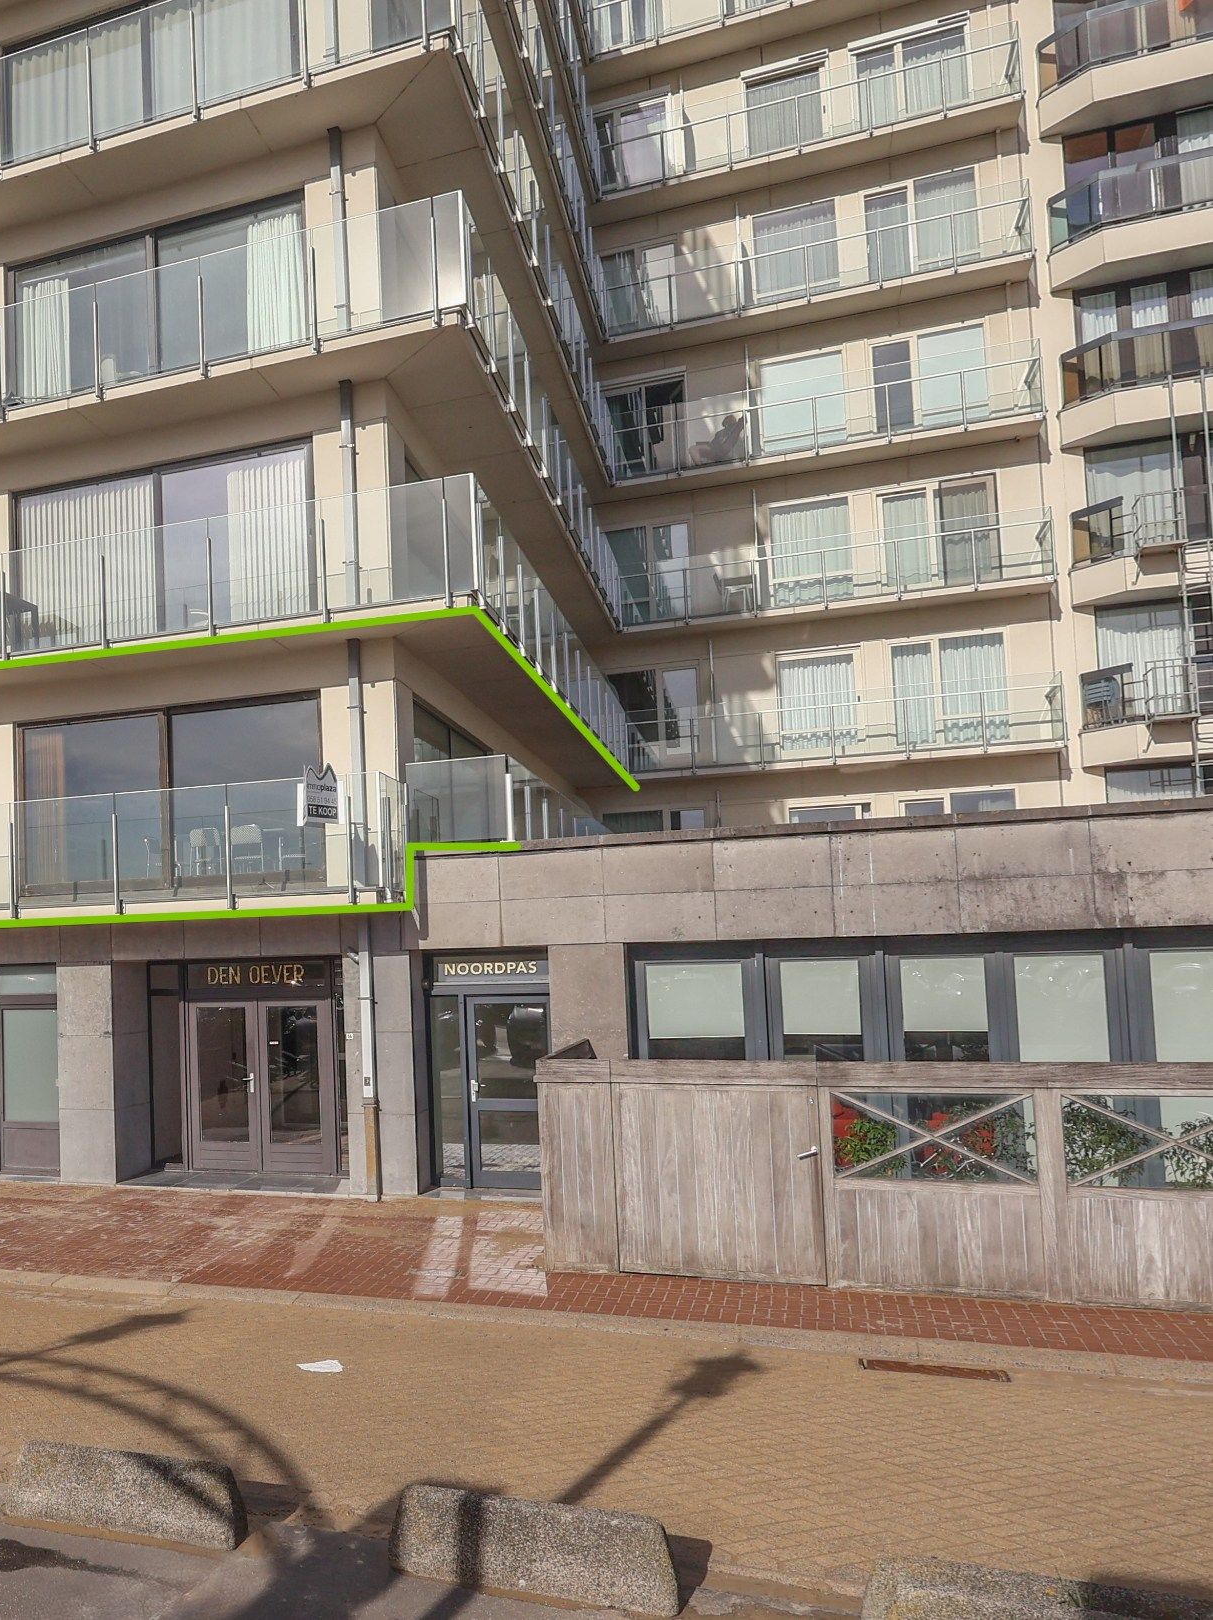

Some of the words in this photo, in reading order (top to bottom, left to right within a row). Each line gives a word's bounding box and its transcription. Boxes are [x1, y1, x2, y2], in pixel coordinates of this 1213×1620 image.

[308, 805, 318, 815] TE
[318, 806, 337, 817] KOOP
[207, 965, 241, 985] DEN
[249, 964, 305, 985] OEVER
[444, 961, 537, 976] NOORDPAS
